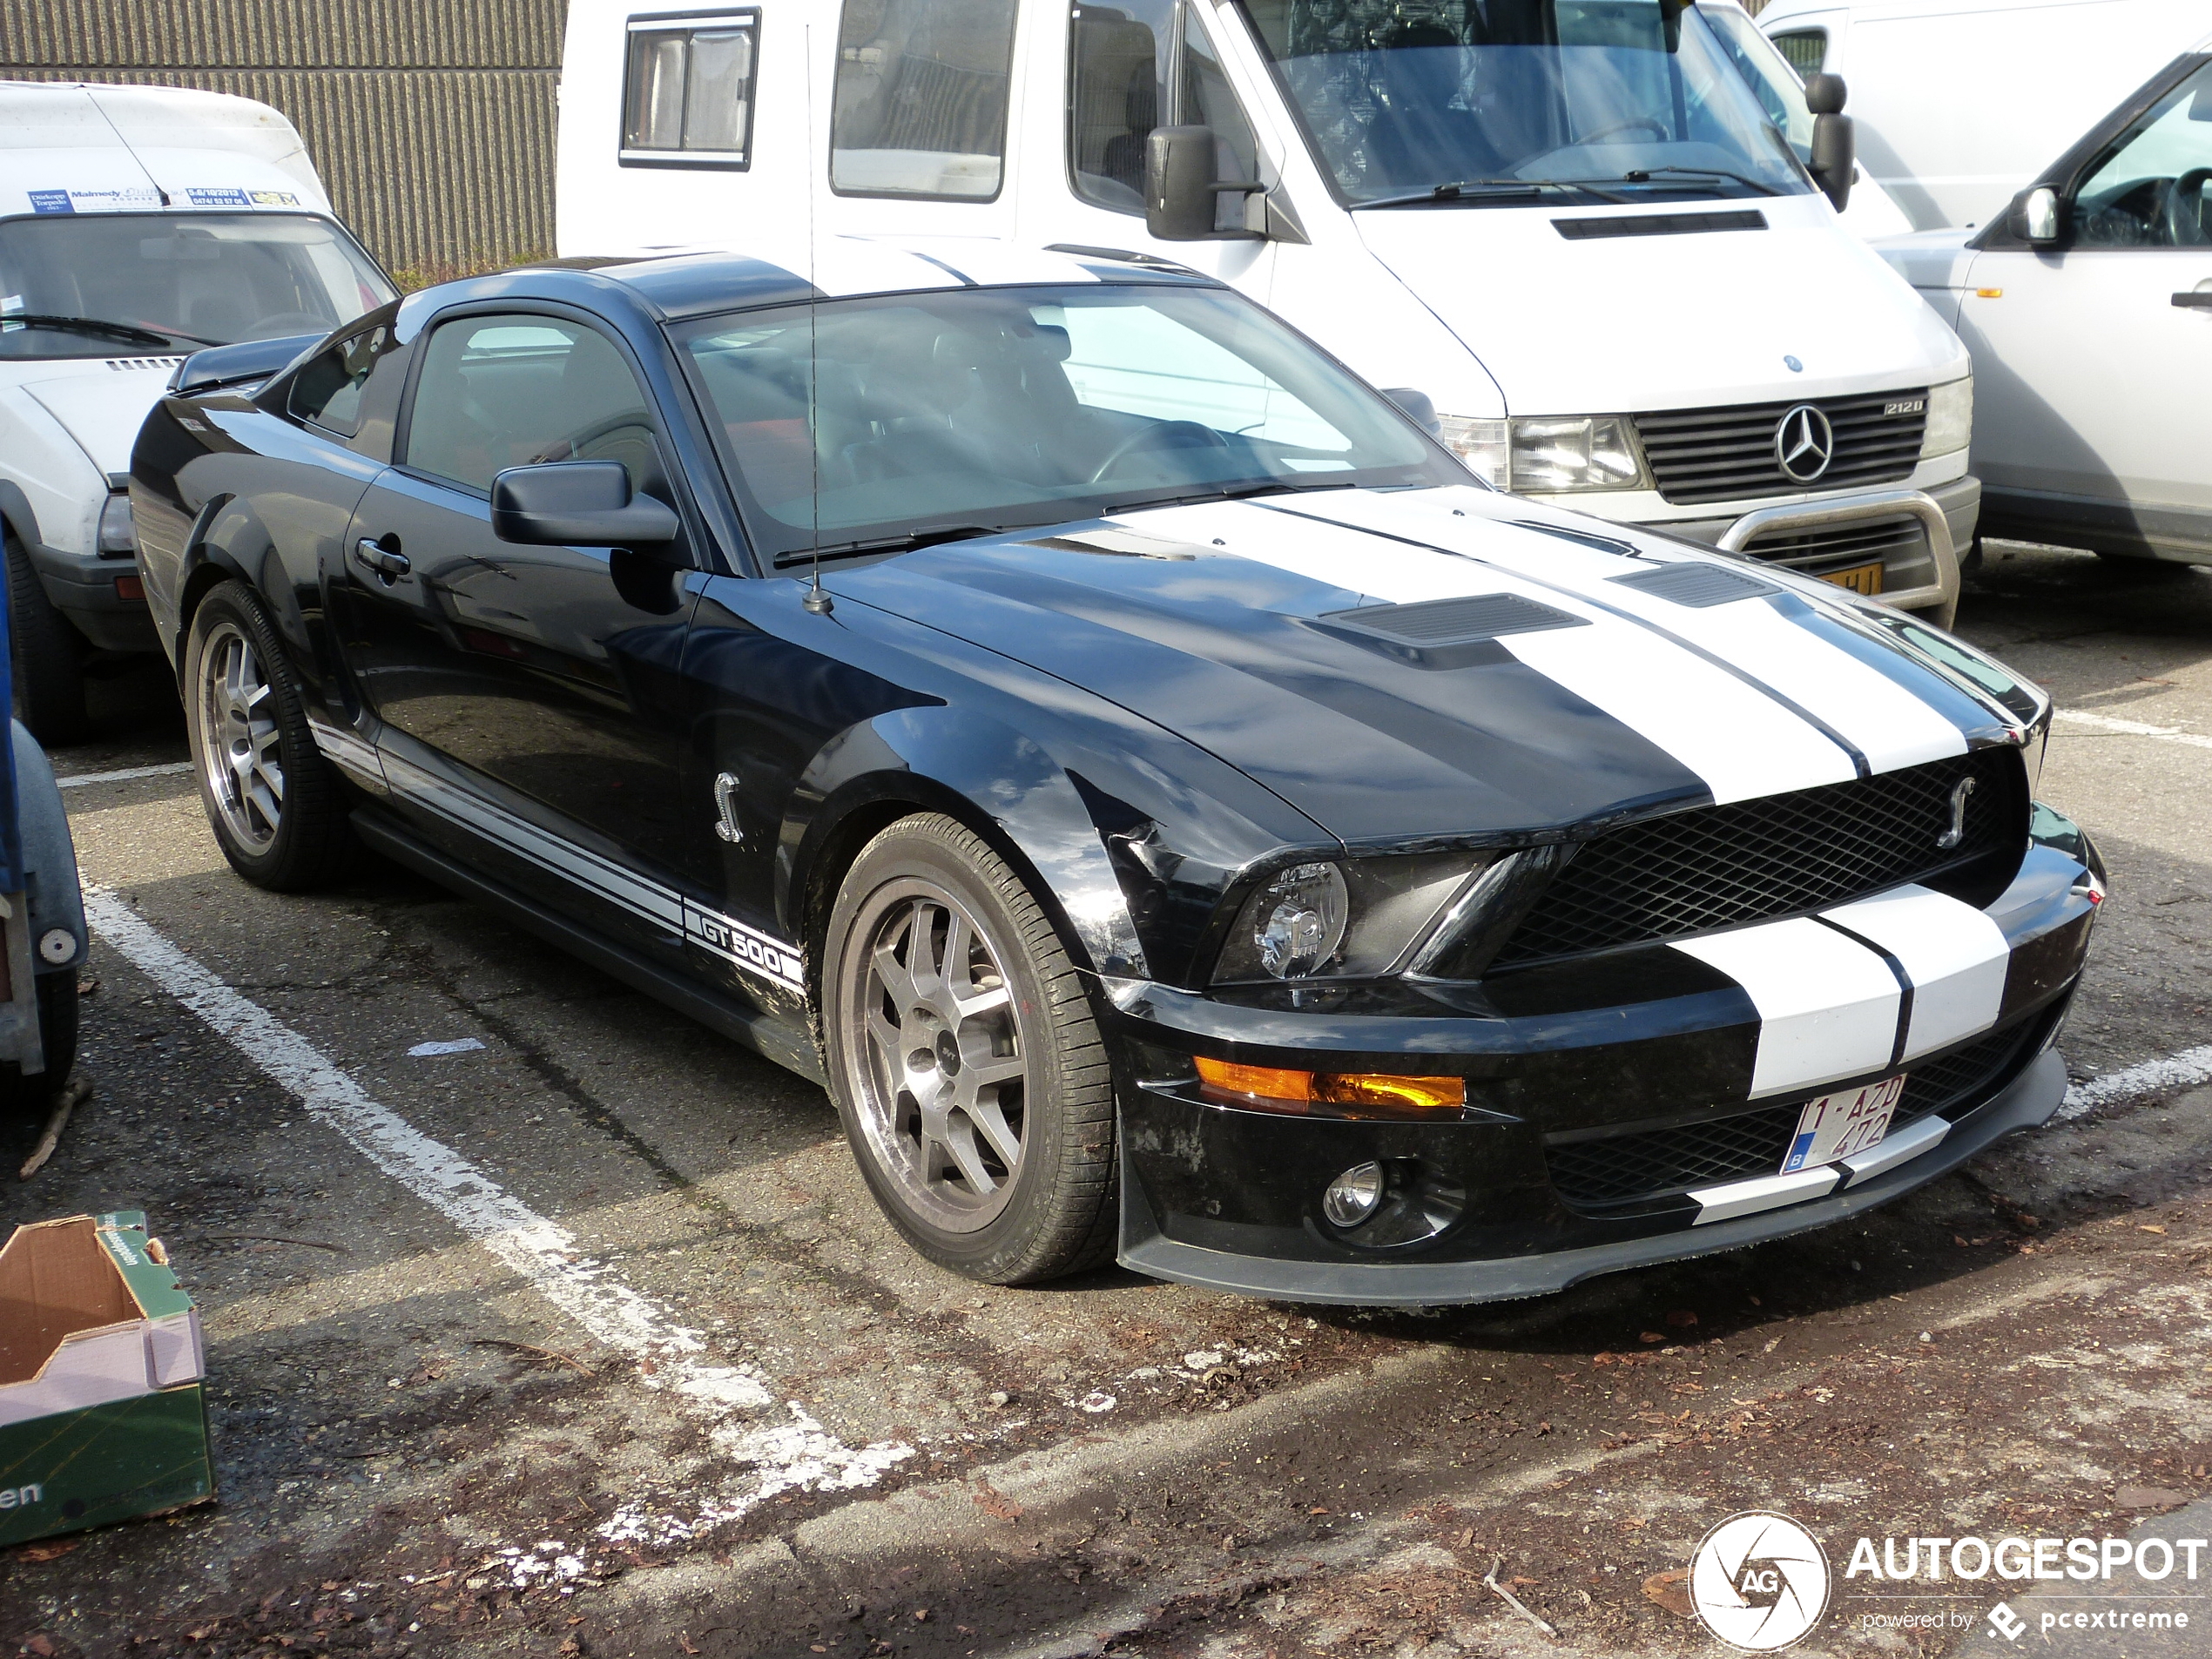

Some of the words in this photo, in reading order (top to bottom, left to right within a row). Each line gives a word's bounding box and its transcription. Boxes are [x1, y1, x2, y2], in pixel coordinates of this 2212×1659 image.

[702, 917, 729, 948] GT
[732, 930, 781, 974] 500
[1831, 1113, 1888, 1156] 472
[1791, 1154, 1802, 1167] B
